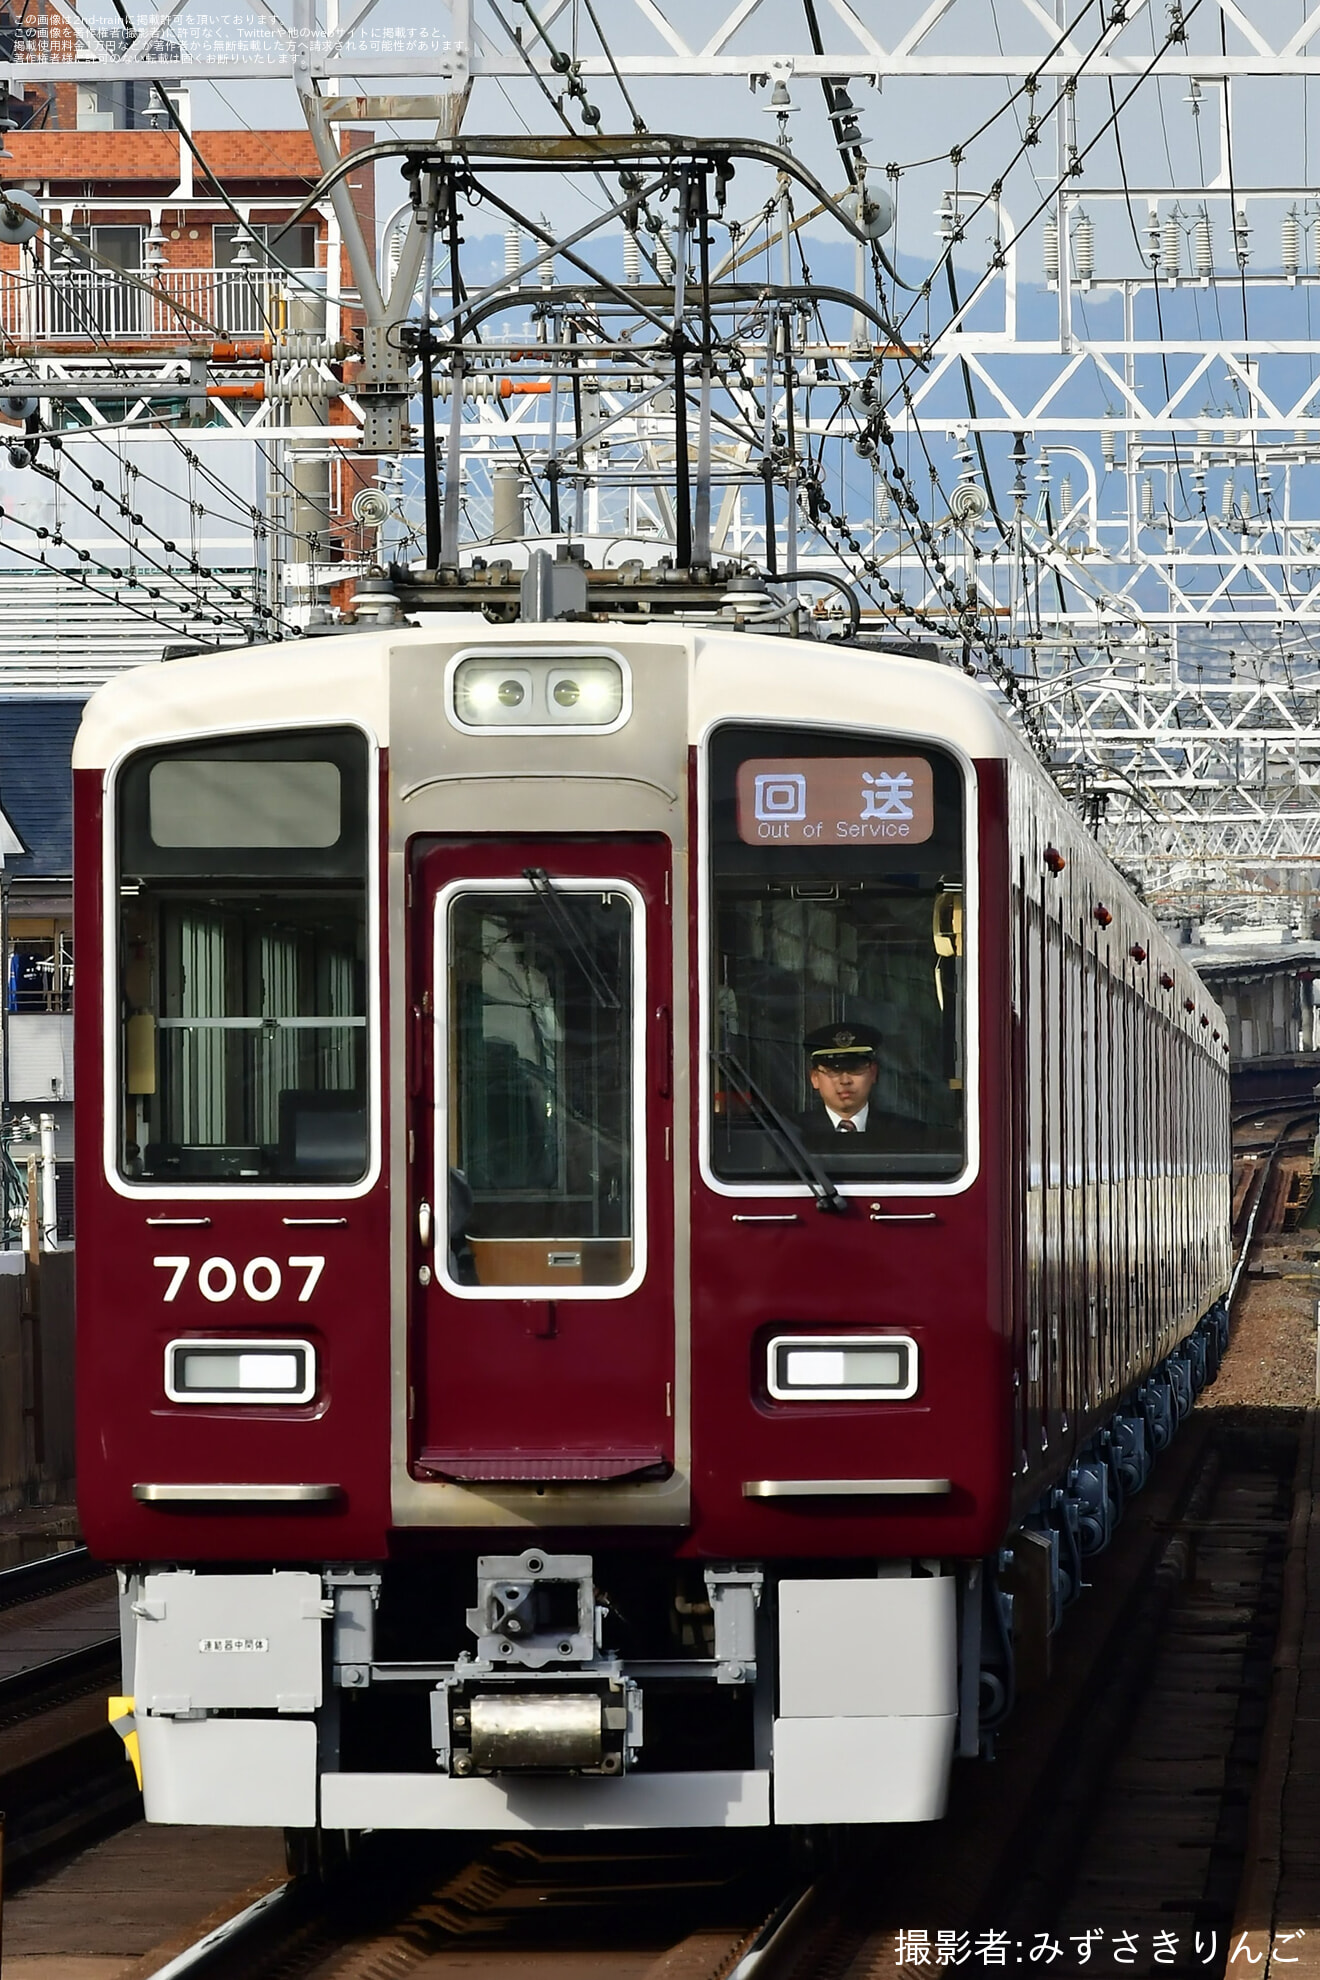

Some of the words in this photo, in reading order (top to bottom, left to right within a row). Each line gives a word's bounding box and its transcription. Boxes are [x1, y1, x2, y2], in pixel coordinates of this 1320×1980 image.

[755, 771, 914, 820] 回送
[758, 822, 790, 838] Out
[803, 821, 824, 837] of
[836, 821, 910, 838] Service
[153, 1256, 326, 1302] 7007
